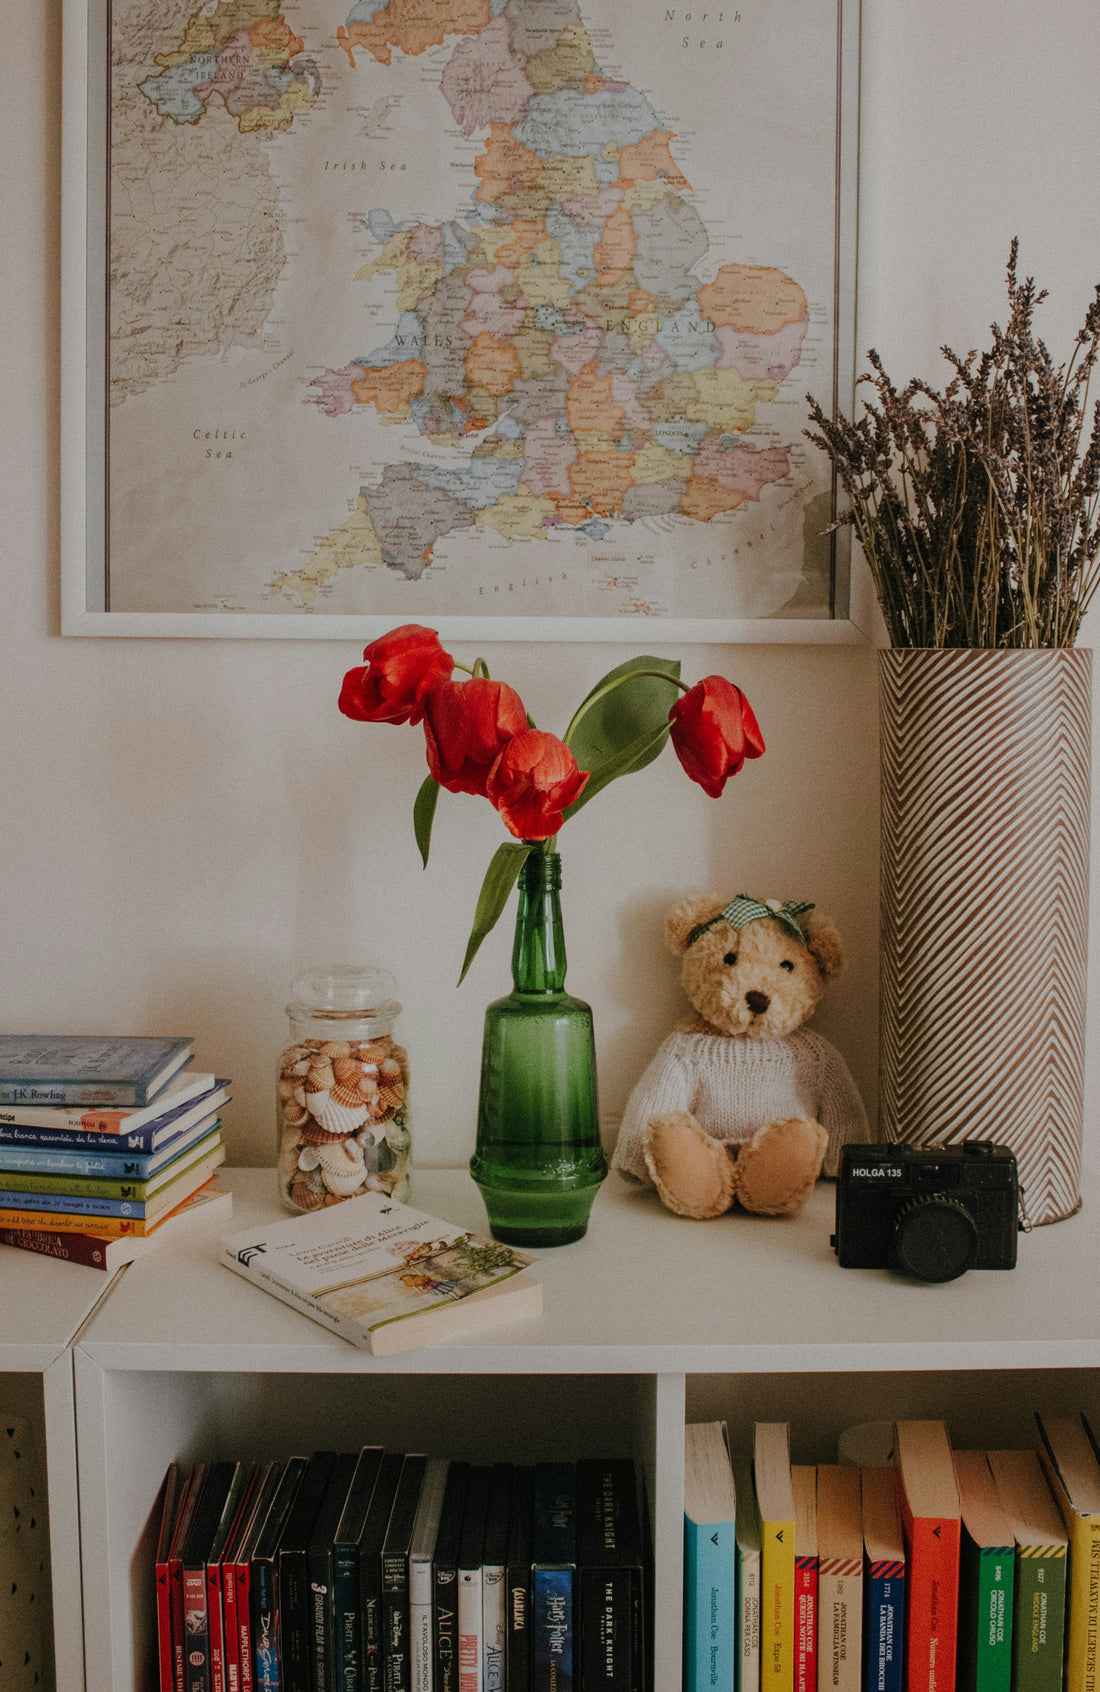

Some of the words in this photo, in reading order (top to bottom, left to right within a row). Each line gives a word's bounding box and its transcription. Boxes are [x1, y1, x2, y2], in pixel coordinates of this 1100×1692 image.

[664, 10, 744, 23] North
[682, 37, 725, 49] Sea
[189, 55, 250, 64] NORTHERN
[195, 71, 244, 80] IRELAND
[324, 160, 371, 172] Irish
[379, 160, 408, 172] Sea
[606, 319, 716, 333] ENGLAND
[394, 334, 453, 347] WALES
[192, 429, 246, 440] Celtic
[204, 448, 233, 459] Sea
[852, 1168, 886, 1178] HOLGA
[886, 1168, 902, 1178] 135
[17, 1236, 69, 1259] CIOCCOLATO
[602, 1472, 613, 1488] THE
[603, 1491, 614, 1513] DARK
[604, 1516, 616, 1549] KNIGHT
[1091, 1539, 1100, 1559] SIM
[225, 1572, 234, 1604] Feltrinelli
[310, 1582, 328, 1594] 3
[605, 1582, 613, 1602] THE
[930, 1579, 940, 1616] Jonathan
[1089, 1560, 1100, 1614] MAXWELL
[314, 1594, 325, 1624] GRANDI
[512, 1587, 526, 1630] CASABLANCA
[545, 1593, 566, 1623] Harry
[710, 1587, 719, 1623] Jonathan
[774, 1584, 783, 1620] Jonathan
[833, 1602, 840, 1612] LA
[880, 1604, 887, 1615] LA
[996, 1589, 1005, 1627] JONATHAN
[1032, 1592, 1040, 1618] MIDDLE
[1039, 1592, 1047, 1629] JONATHAN
[344, 1612, 355, 1643] PIRATI
[422, 1614, 429, 1622] IL
[605, 1606, 613, 1634] DARK
[774, 1621, 782, 1637] Coe
[886, 1604, 894, 1644] JONATHAN
[930, 1617, 938, 1632] Coe
[1088, 1616, 1098, 1627] DI
[315, 1624, 325, 1644] FILM
[392, 1625, 403, 1647] Disney
[437, 1606, 455, 1660] ALICE
[543, 1623, 568, 1654] Potter
[710, 1625, 719, 1640] Coe
[996, 1627, 1004, 1642] COE
[1031, 1619, 1040, 1653] ENGLAND
[1039, 1630, 1047, 1644] COE
[240, 1625, 250, 1682] MAPPLETHORPE
[460, 1634, 478, 1668] PRETTY
[486, 1642, 504, 1679] ALICE
[606, 1639, 614, 1678] KNIGHT
[772, 1642, 782, 1662] Expo
[799, 1652, 806, 1663] MI
[929, 1637, 938, 1669] Numero
[1086, 1629, 1097, 1673] SEGRETI
[391, 1653, 404, 1685] PIRATI
[710, 1645, 719, 1686] Bournville
[774, 1663, 782, 1673] 58
[799, 1663, 806, 1675] HA
[878, 1657, 886, 1691] BROCCHI
